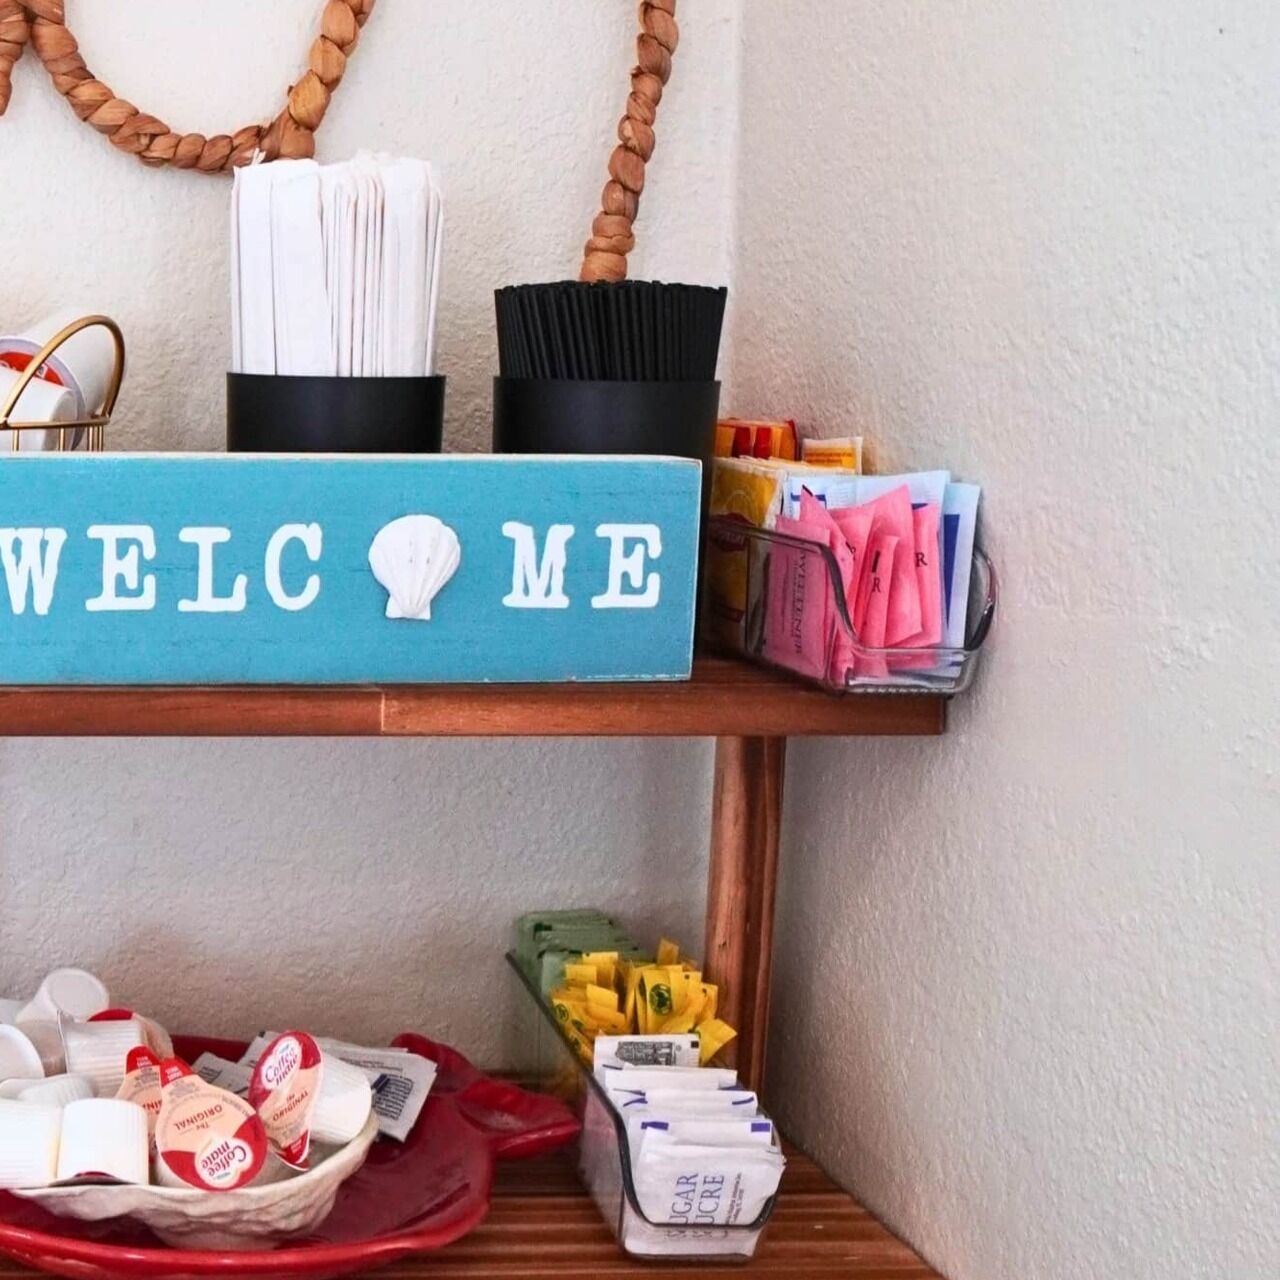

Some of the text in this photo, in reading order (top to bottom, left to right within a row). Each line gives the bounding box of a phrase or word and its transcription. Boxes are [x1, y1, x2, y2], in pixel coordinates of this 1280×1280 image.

[173, 1103, 224, 1131] ORIGINAL
[201, 1140, 231, 1169] mate
[208, 1144, 248, 1178] Coffee
